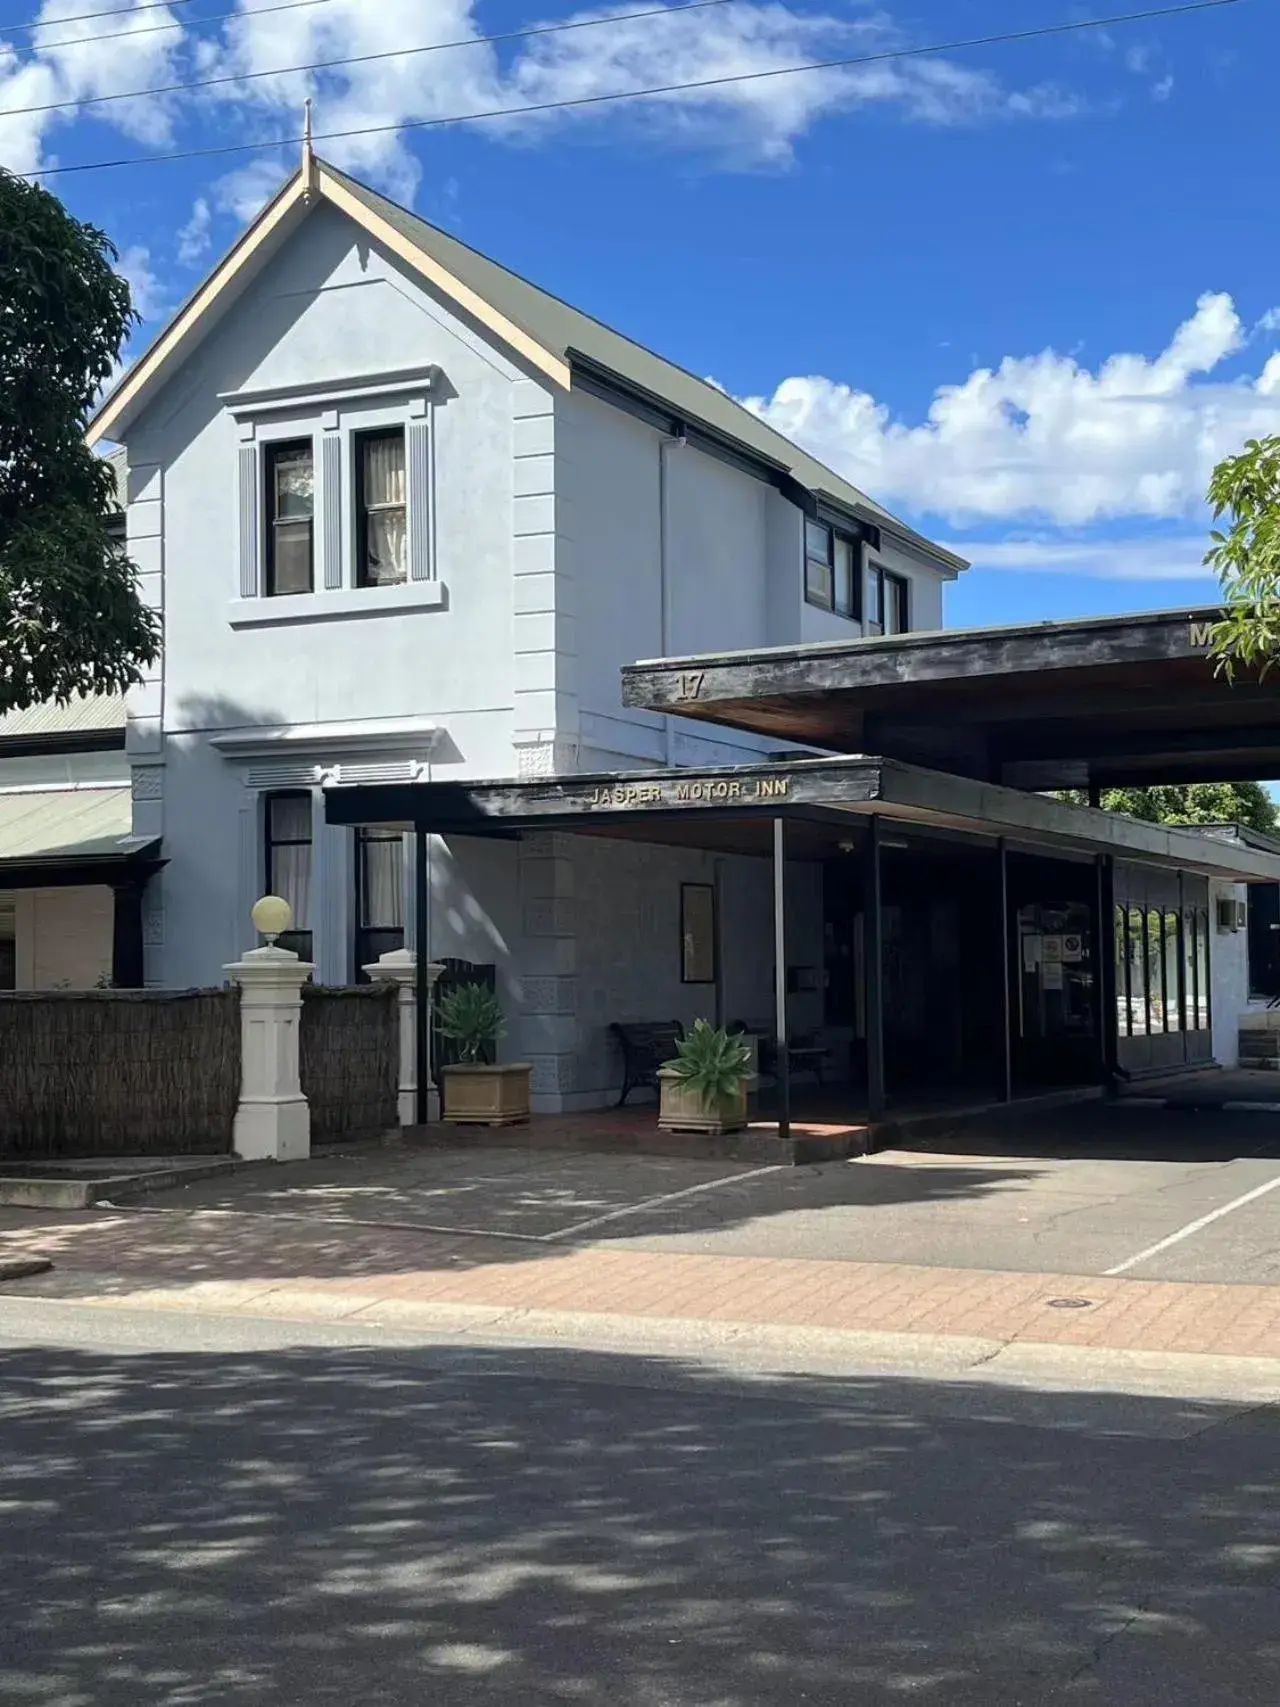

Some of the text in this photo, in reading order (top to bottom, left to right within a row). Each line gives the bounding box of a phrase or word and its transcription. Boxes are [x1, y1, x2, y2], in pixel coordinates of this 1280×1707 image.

[675, 671, 705, 700] 17
[590, 779, 787, 804] JASPER MOTOR INN
